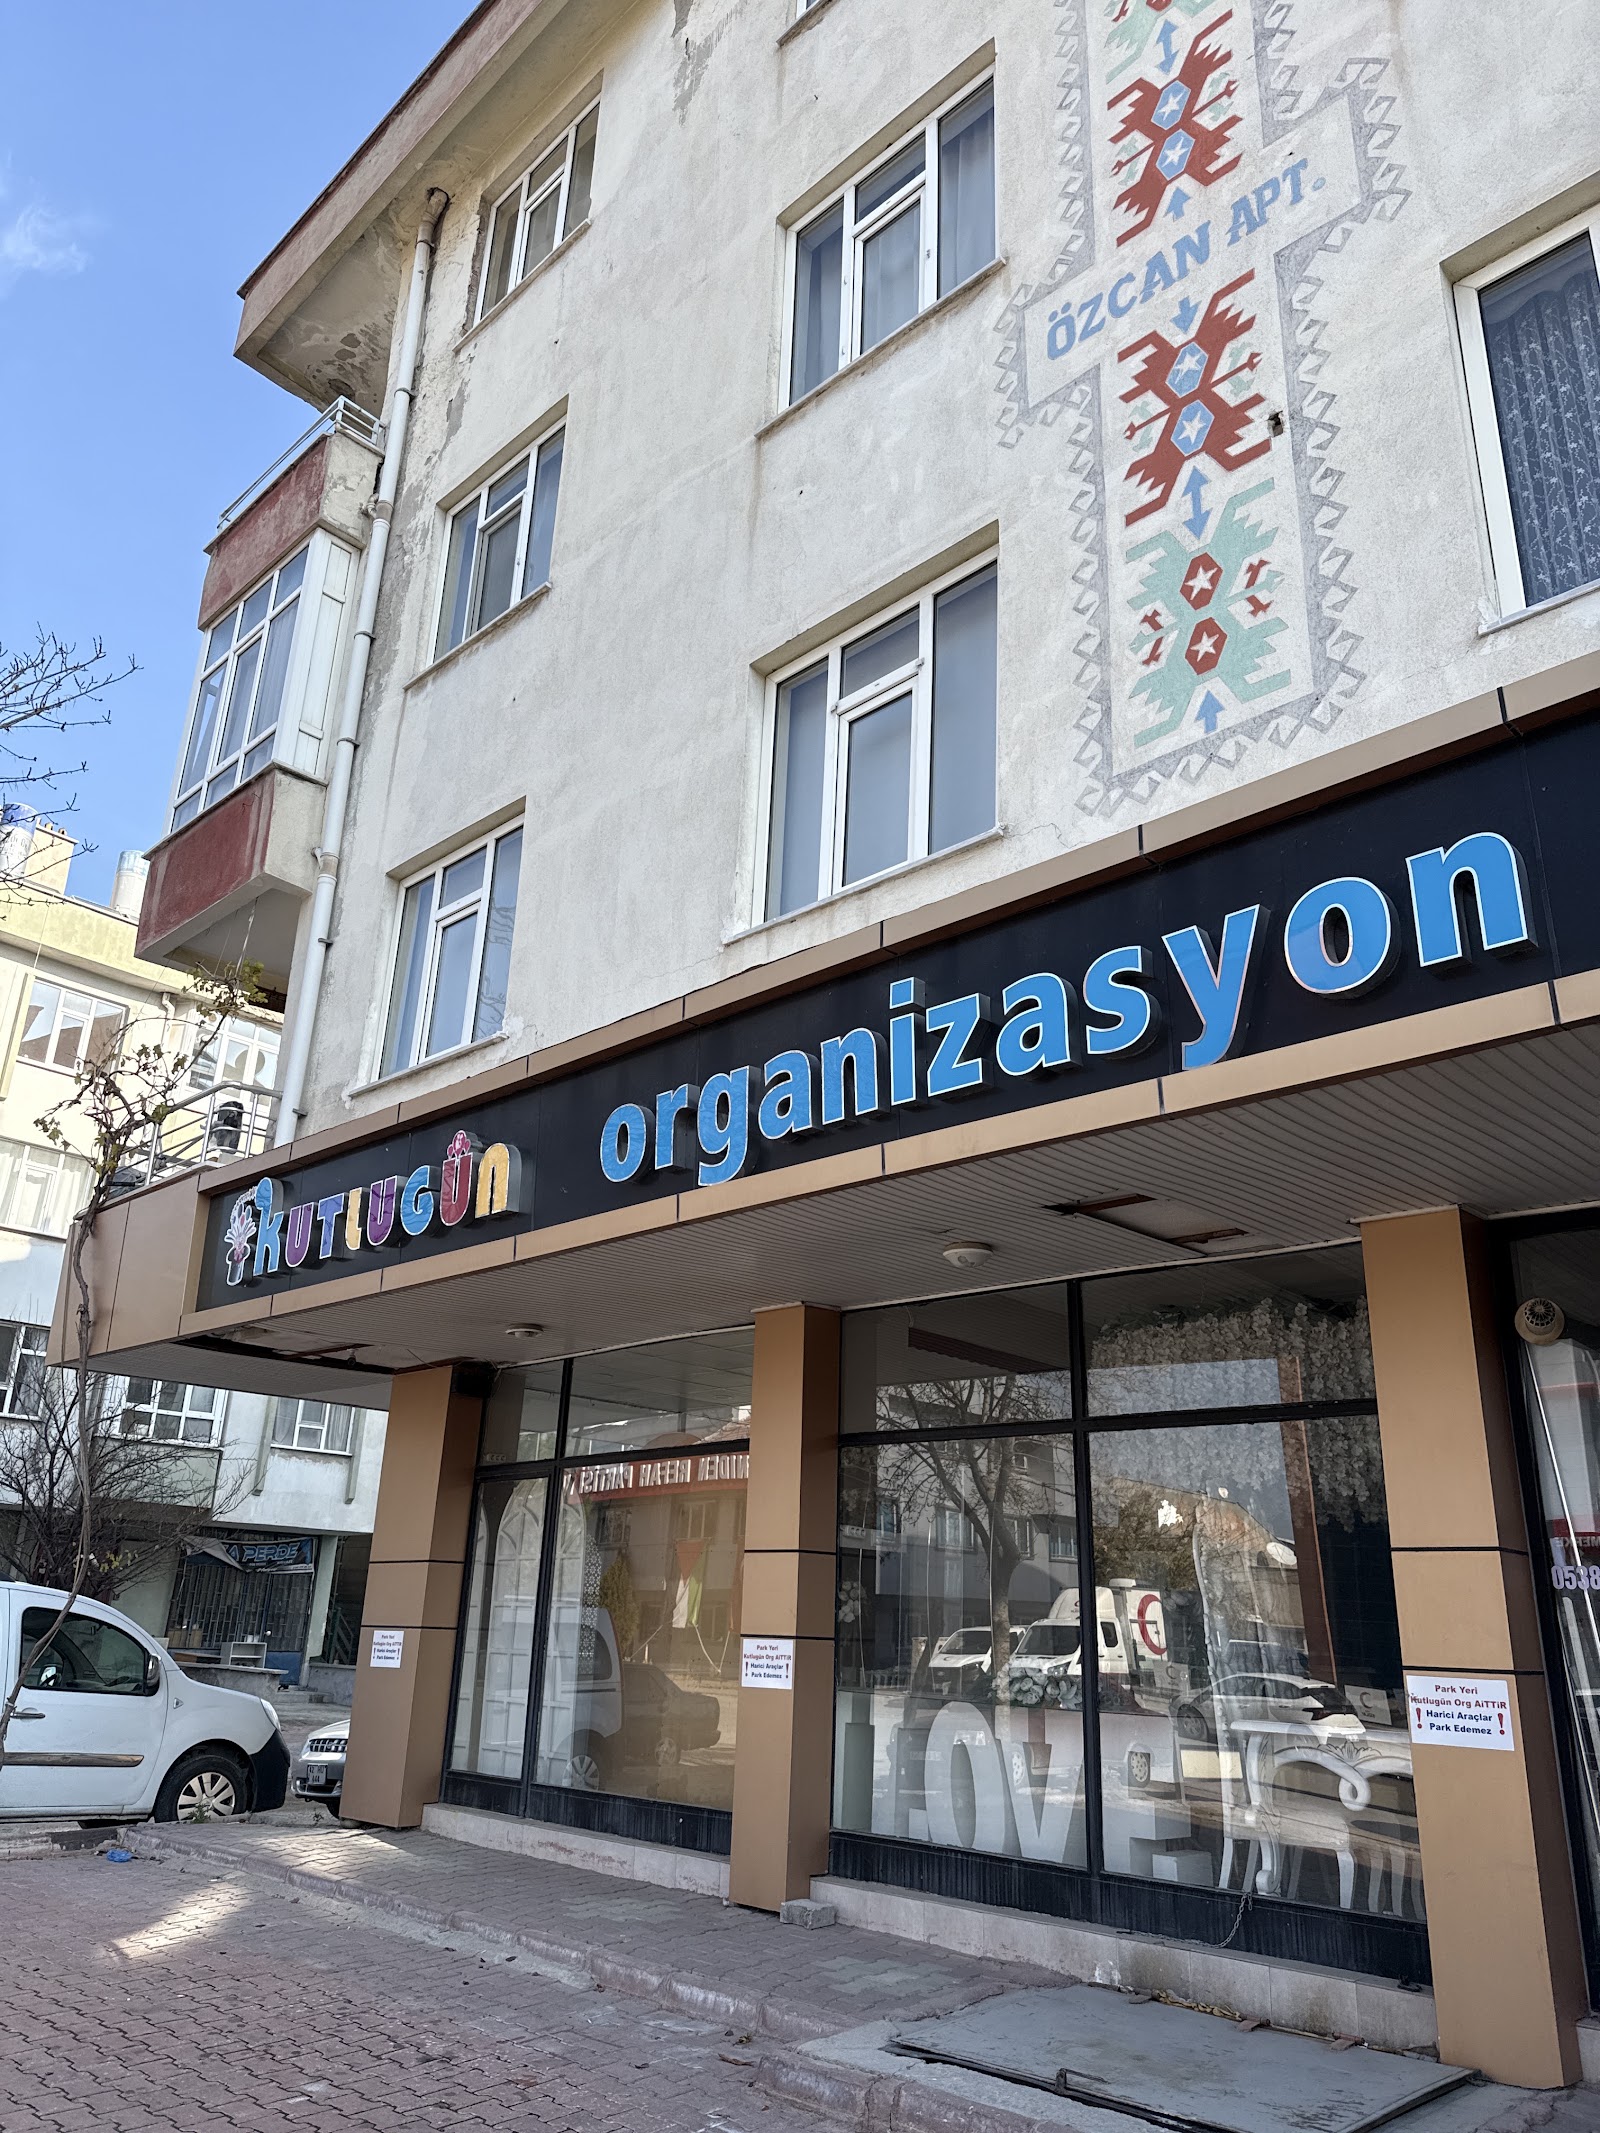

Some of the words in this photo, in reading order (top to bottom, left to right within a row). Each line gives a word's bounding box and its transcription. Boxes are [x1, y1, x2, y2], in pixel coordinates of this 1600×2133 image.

[1047, 220, 1212, 360] ÖZCAN
[1225, 157, 1327, 247] APT.
[599, 831, 1529, 1188] organizasyon
[241, 1543, 301, 1562] PERDE
[1551, 1565, 1600, 1590] 0538
[1434, 1684, 1457, 1693] Park
[1459, 1685, 1478, 1694] Yeri
[1410, 1695, 1452, 1707] Kutlugün
[1454, 1698, 1472, 1709] Org
[1426, 1709, 1455, 1719] Harici
[1457, 1711, 1493, 1722] Araçlar
[1429, 1722, 1452, 1732] Park
[1454, 1724, 1492, 1735] Edemez
